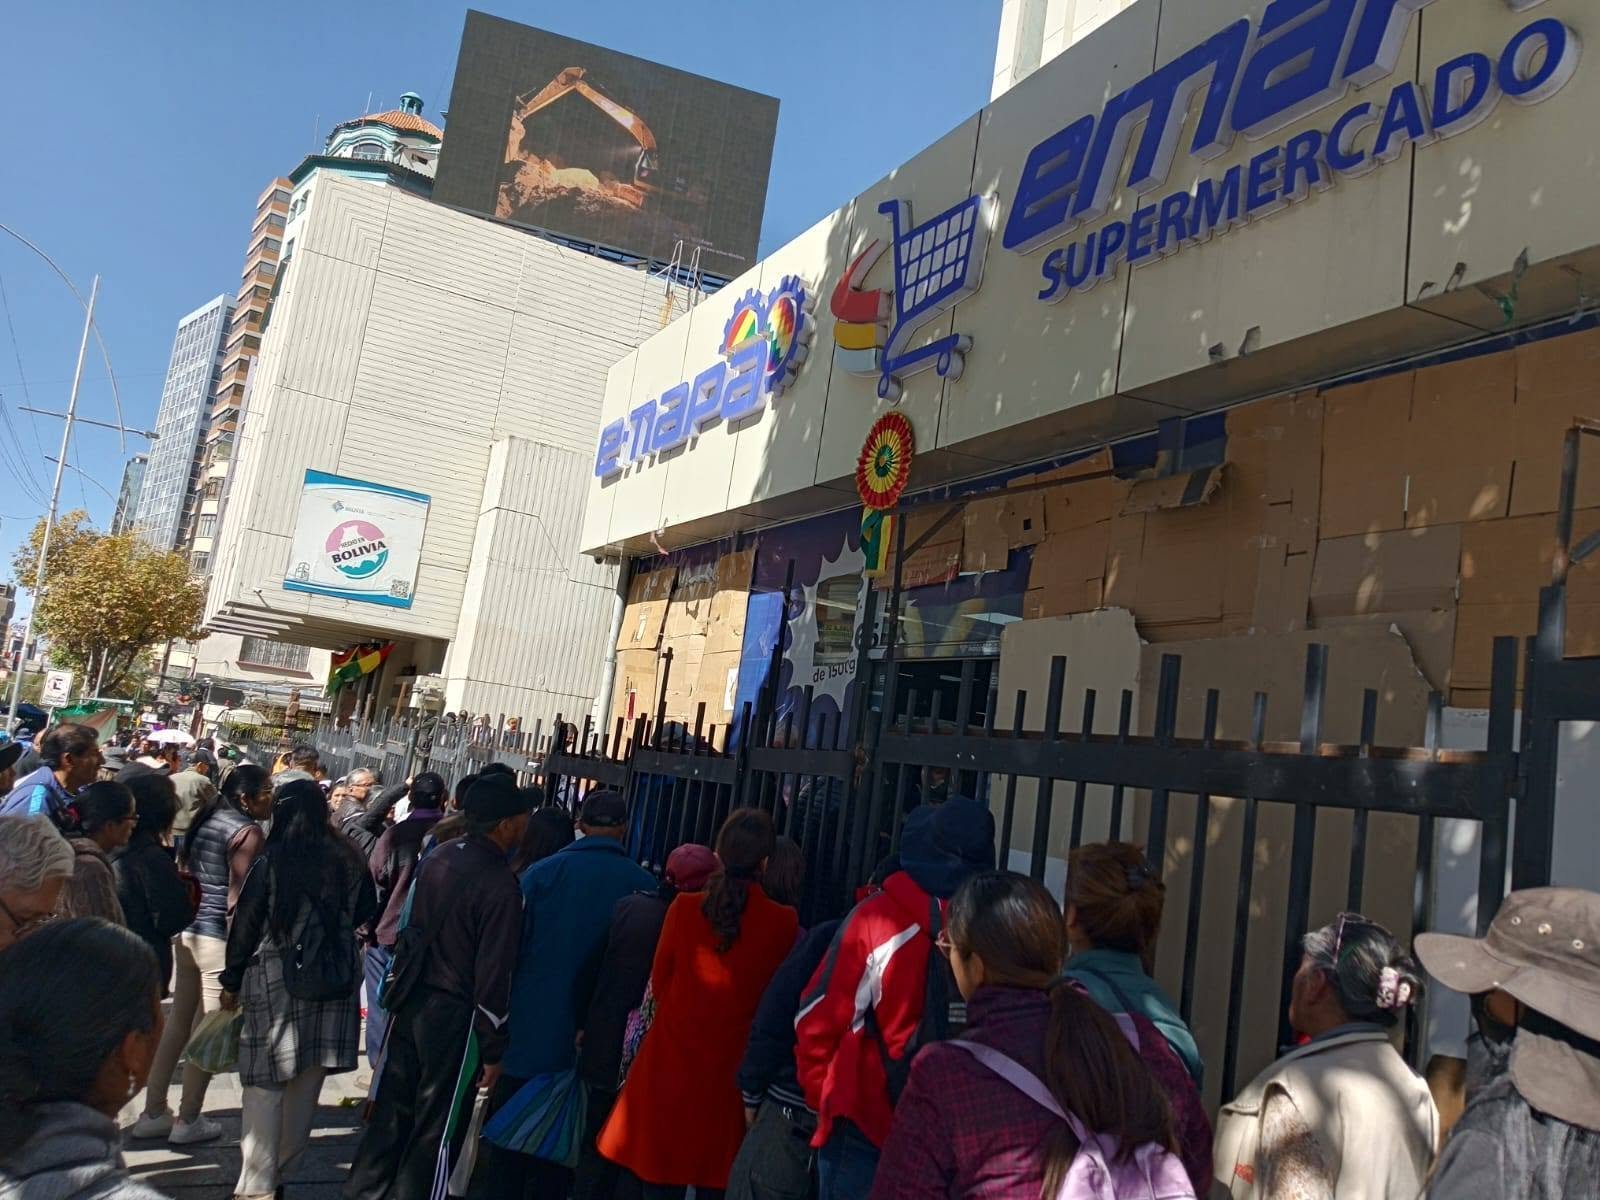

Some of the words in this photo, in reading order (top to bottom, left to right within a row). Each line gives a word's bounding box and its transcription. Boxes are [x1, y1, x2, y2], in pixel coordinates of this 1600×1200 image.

[1038, 17, 1574, 302] SUPERMERCADO
[332, 541, 387, 563] BOLIVIA
[812, 667, 826, 683] de
